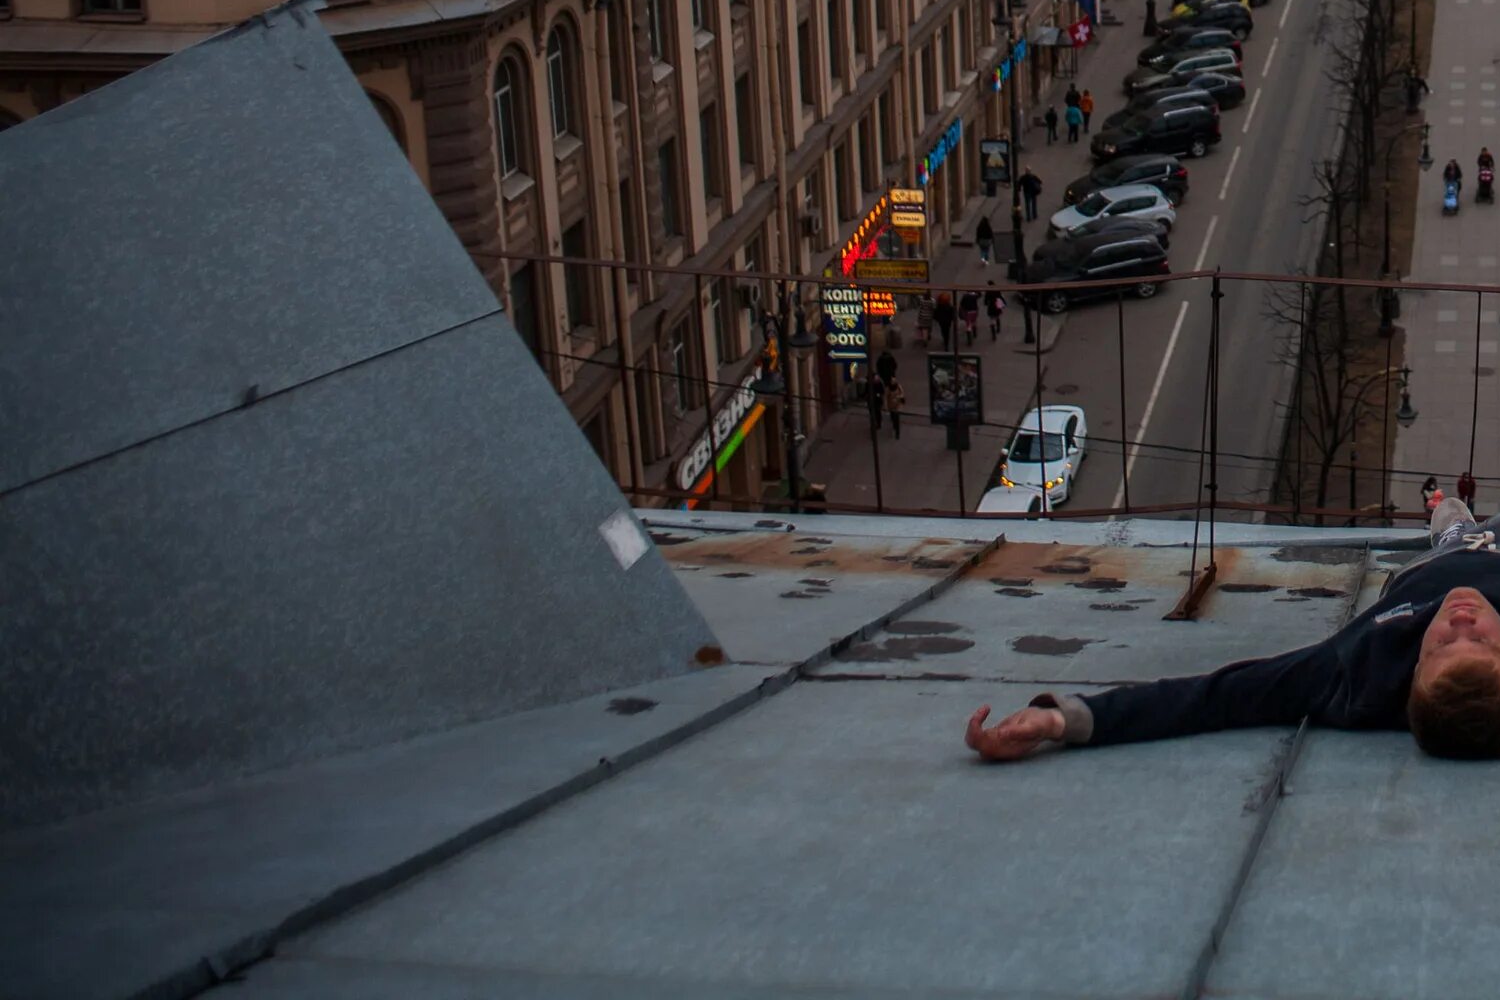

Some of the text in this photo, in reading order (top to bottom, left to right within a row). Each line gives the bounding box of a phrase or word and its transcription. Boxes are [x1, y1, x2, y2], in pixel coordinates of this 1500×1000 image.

[823, 288, 863, 302] КОПИ
[823, 302, 863, 316] ЦЕНТР
[825, 332, 867, 347] ФОТО
